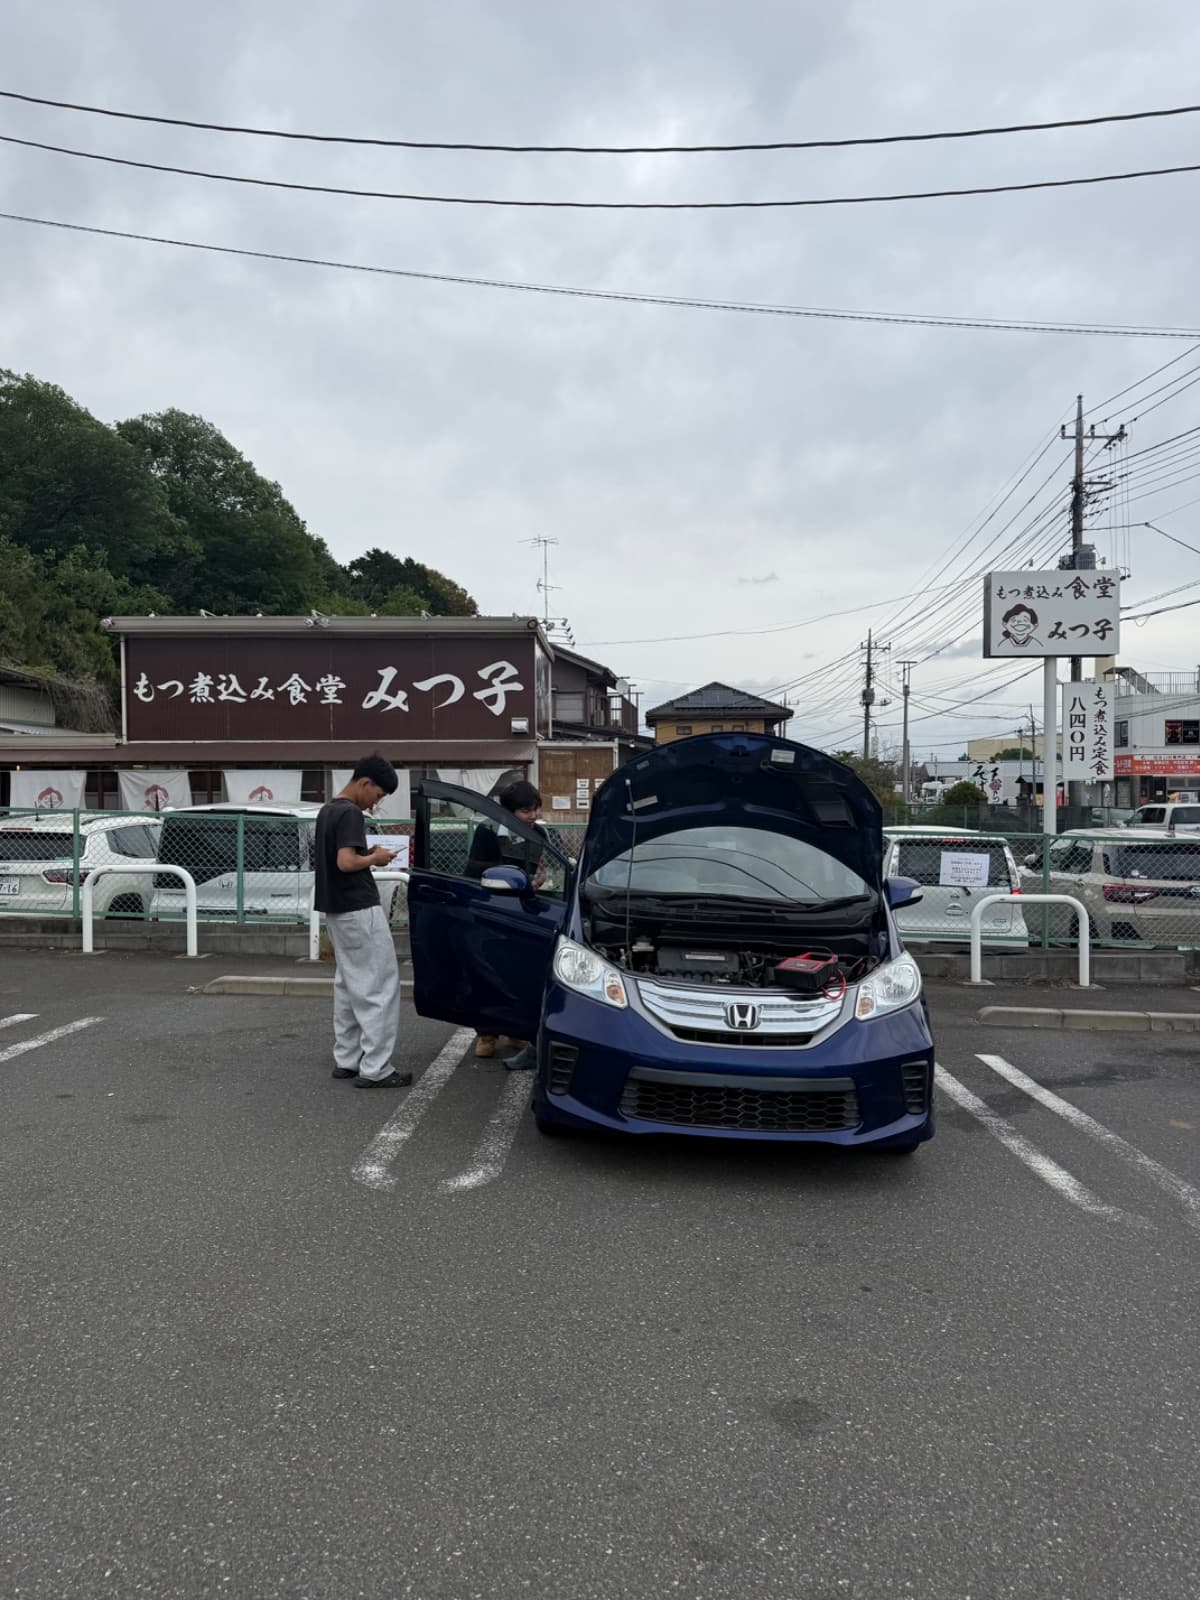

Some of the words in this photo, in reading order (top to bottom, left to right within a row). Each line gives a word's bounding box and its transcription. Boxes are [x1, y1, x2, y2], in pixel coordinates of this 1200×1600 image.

[996, 576, 1116, 600] もつ煮込み食堂
[1048, 618, 1114, 640] みつ子
[133, 672, 347, 705] もつ煮込み食堂
[361, 660, 524, 716] みつ子
[1089, 686, 1110, 776] もつ煮込み定食
